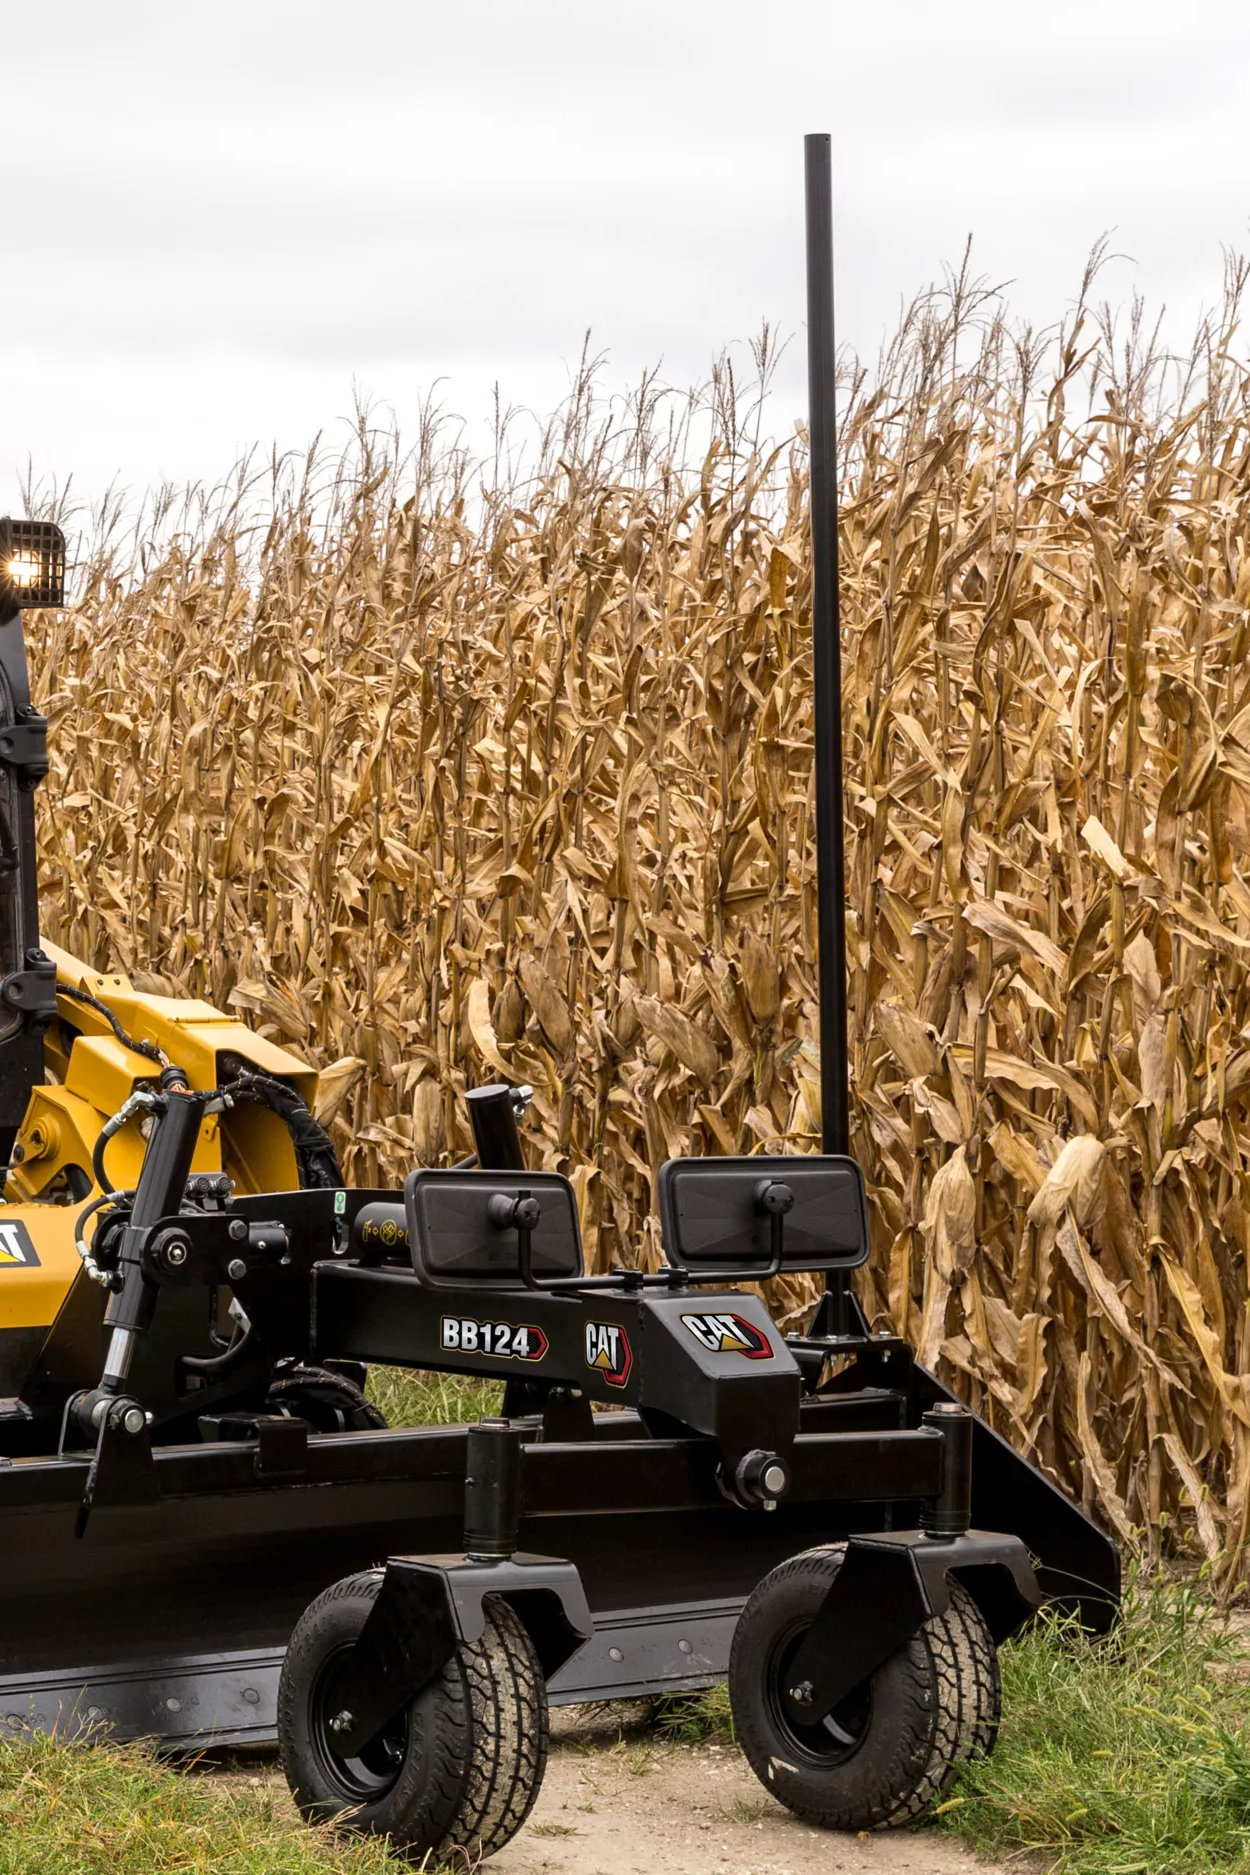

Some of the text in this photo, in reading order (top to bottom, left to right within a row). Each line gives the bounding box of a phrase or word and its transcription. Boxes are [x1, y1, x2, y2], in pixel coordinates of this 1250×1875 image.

[443, 1318, 530, 1357] BB124
[585, 1323, 619, 1372] CAT
[682, 1314, 755, 1351] CAT
